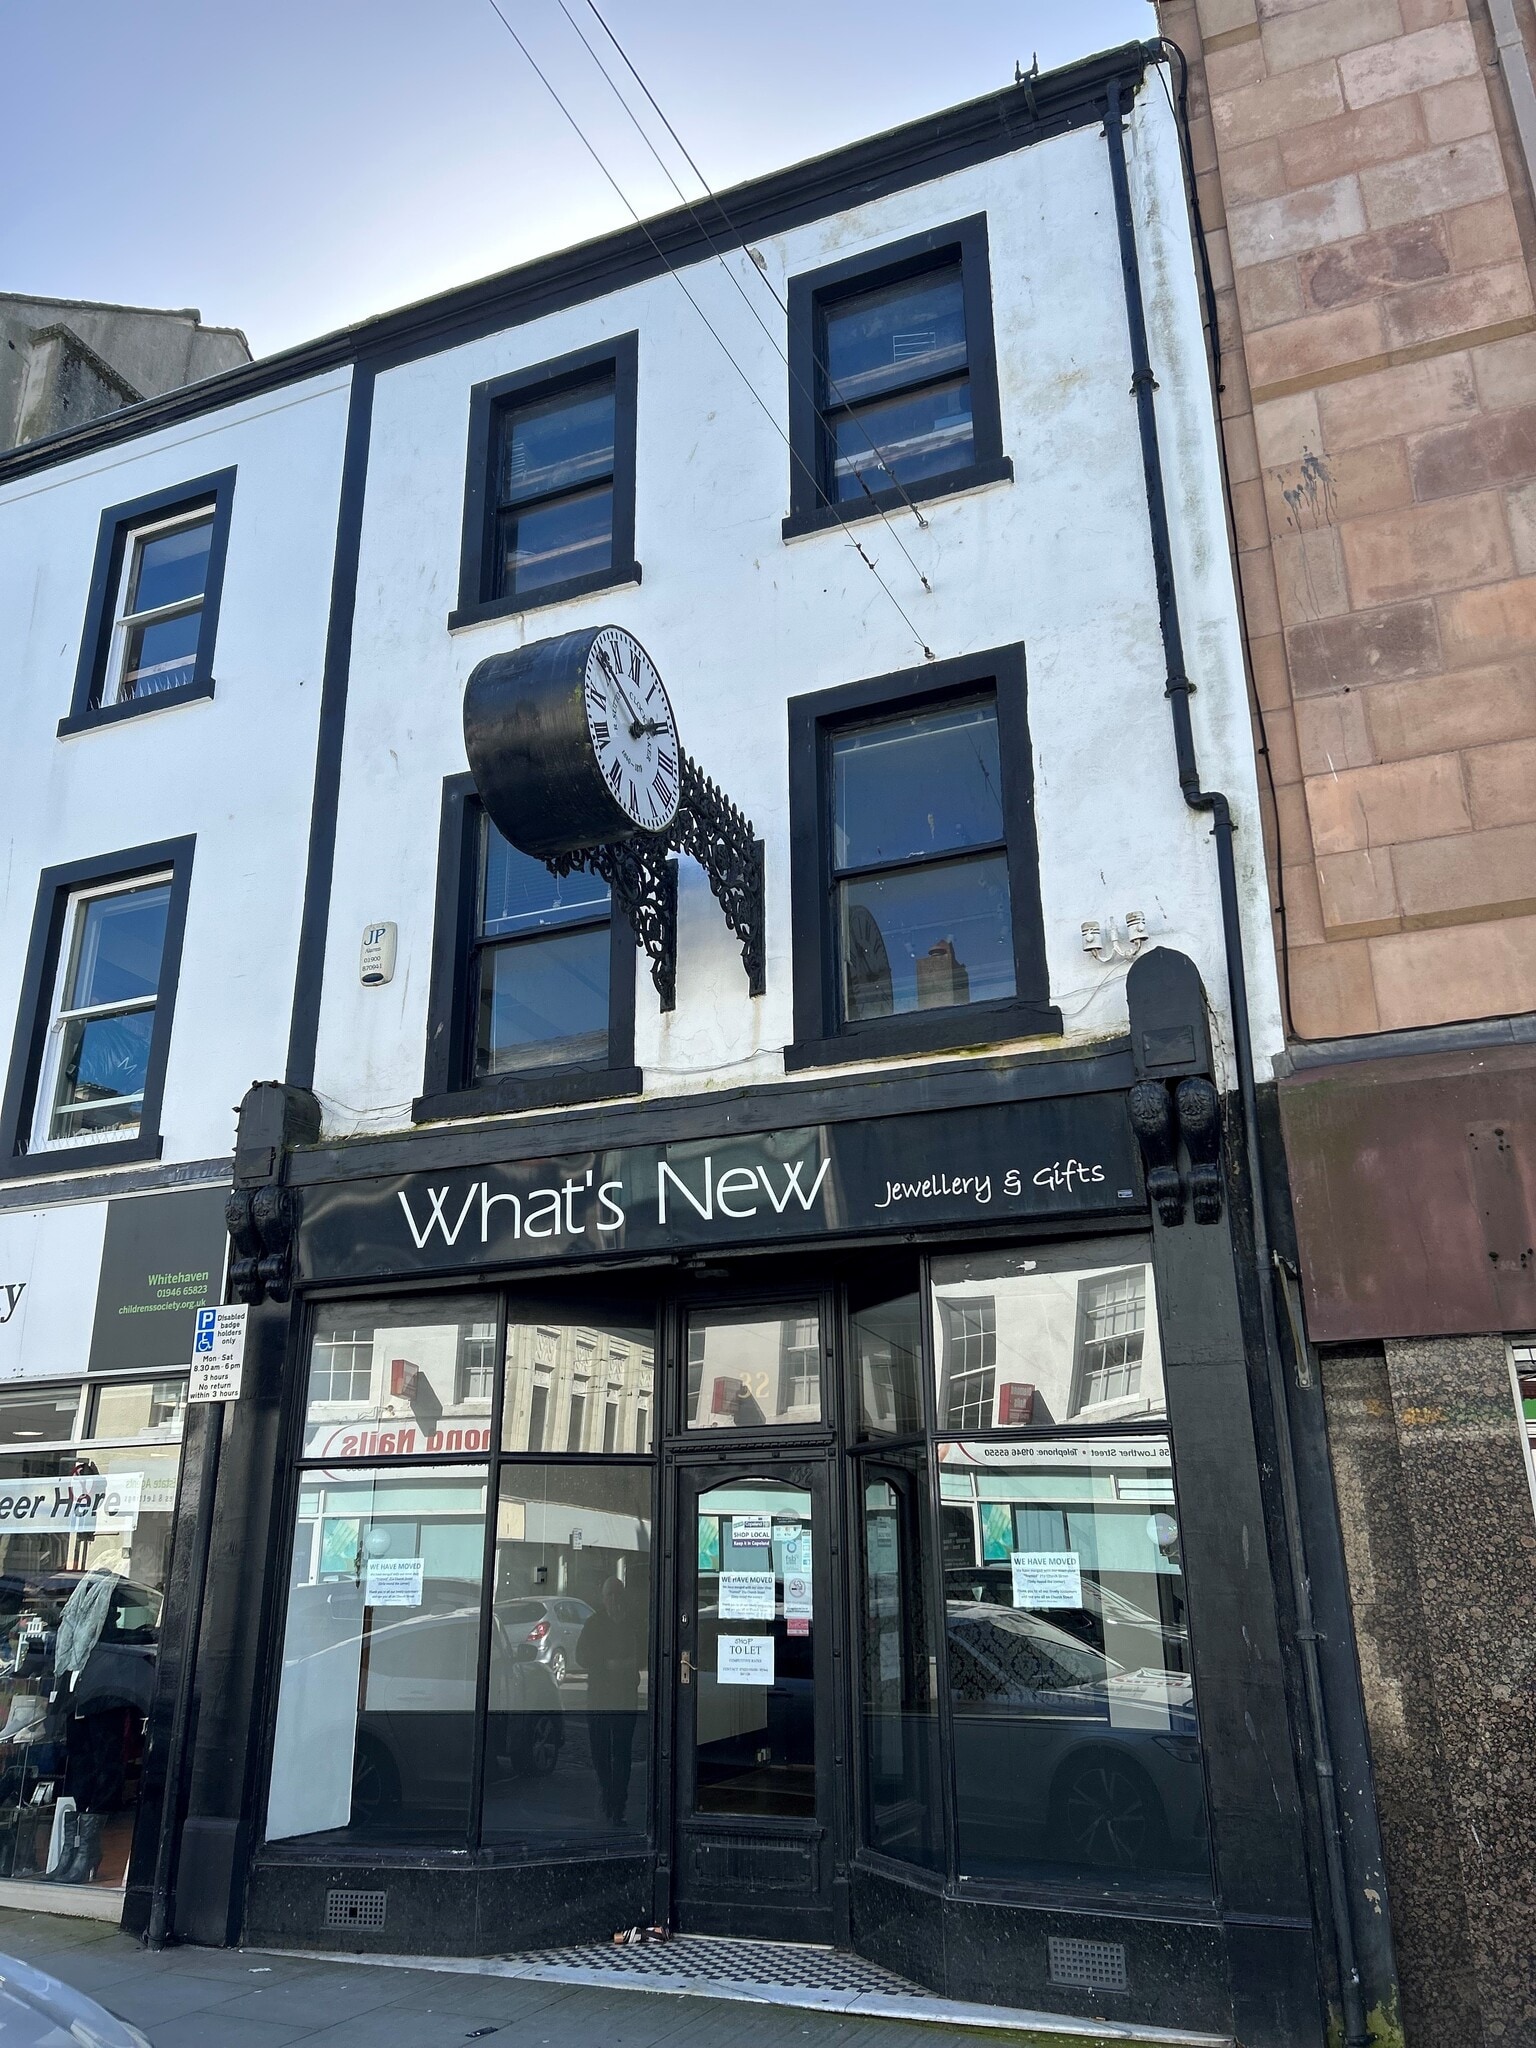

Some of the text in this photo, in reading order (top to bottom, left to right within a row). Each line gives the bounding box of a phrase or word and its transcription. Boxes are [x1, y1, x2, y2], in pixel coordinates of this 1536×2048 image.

[628, 649, 641, 688] XII
[657, 747, 674, 778] III
[652, 768, 672, 809] IIII
[363, 928, 386, 946] JP
[874, 1159, 1106, 1208] Jewellery & Gifts
[398, 1156, 832, 1249] What's New
[148, 1271, 209, 1286] Whitehaven
[157, 1284, 208, 1298] 01946 65823
[118, 1298, 206, 1314] childrenssociety.org.uk
[202, 1312, 214, 1328] P
[217, 1313, 246, 1321] Disabled
[220, 1321, 240, 1329] badge
[217, 1329, 242, 1337] holders
[193, 1364, 210, 1372] 8.30
[230, 1363, 240, 1371] pm
[738, 1371, 770, 1399] 32
[51, 1486, 121, 1519] Here
[398, 1562, 422, 1570] MOVED
[750, 1576, 773, 1584] MOVED
[730, 1646, 762, 1655] TO LET
